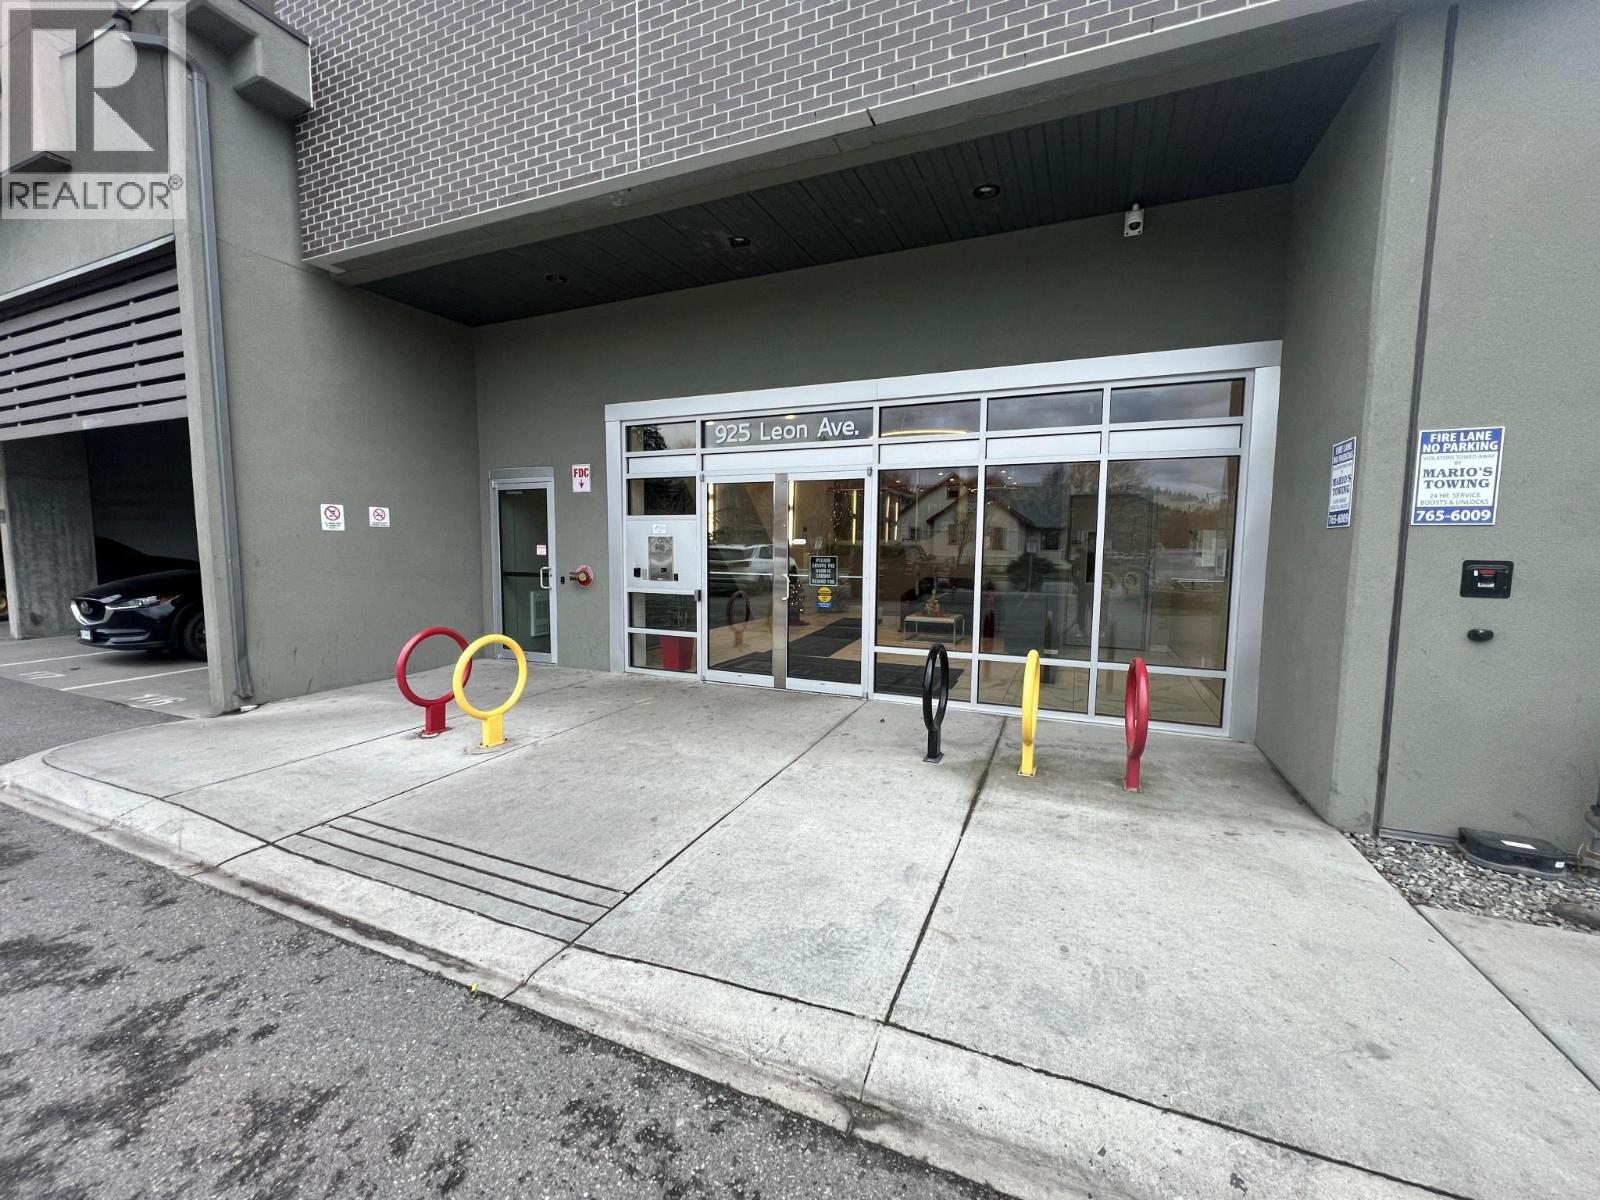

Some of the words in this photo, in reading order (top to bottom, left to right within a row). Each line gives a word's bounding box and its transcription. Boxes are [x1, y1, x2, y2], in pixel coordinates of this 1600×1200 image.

[715, 422, 751, 444] 925
[760, 421, 808, 441] Leon
[817, 417, 860, 438] Ave.
[1430, 432, 1457, 443] FIRE
[1460, 430, 1493, 441] LANE
[1422, 443, 1441, 453] NO
[1442, 441, 1499, 452] PARKING
[573, 467, 589, 478] FDC
[1422, 467, 1493, 478] MARIO'S
[1423, 479, 1490, 489] TOWING
[1416, 509, 1492, 522] 765-6009
